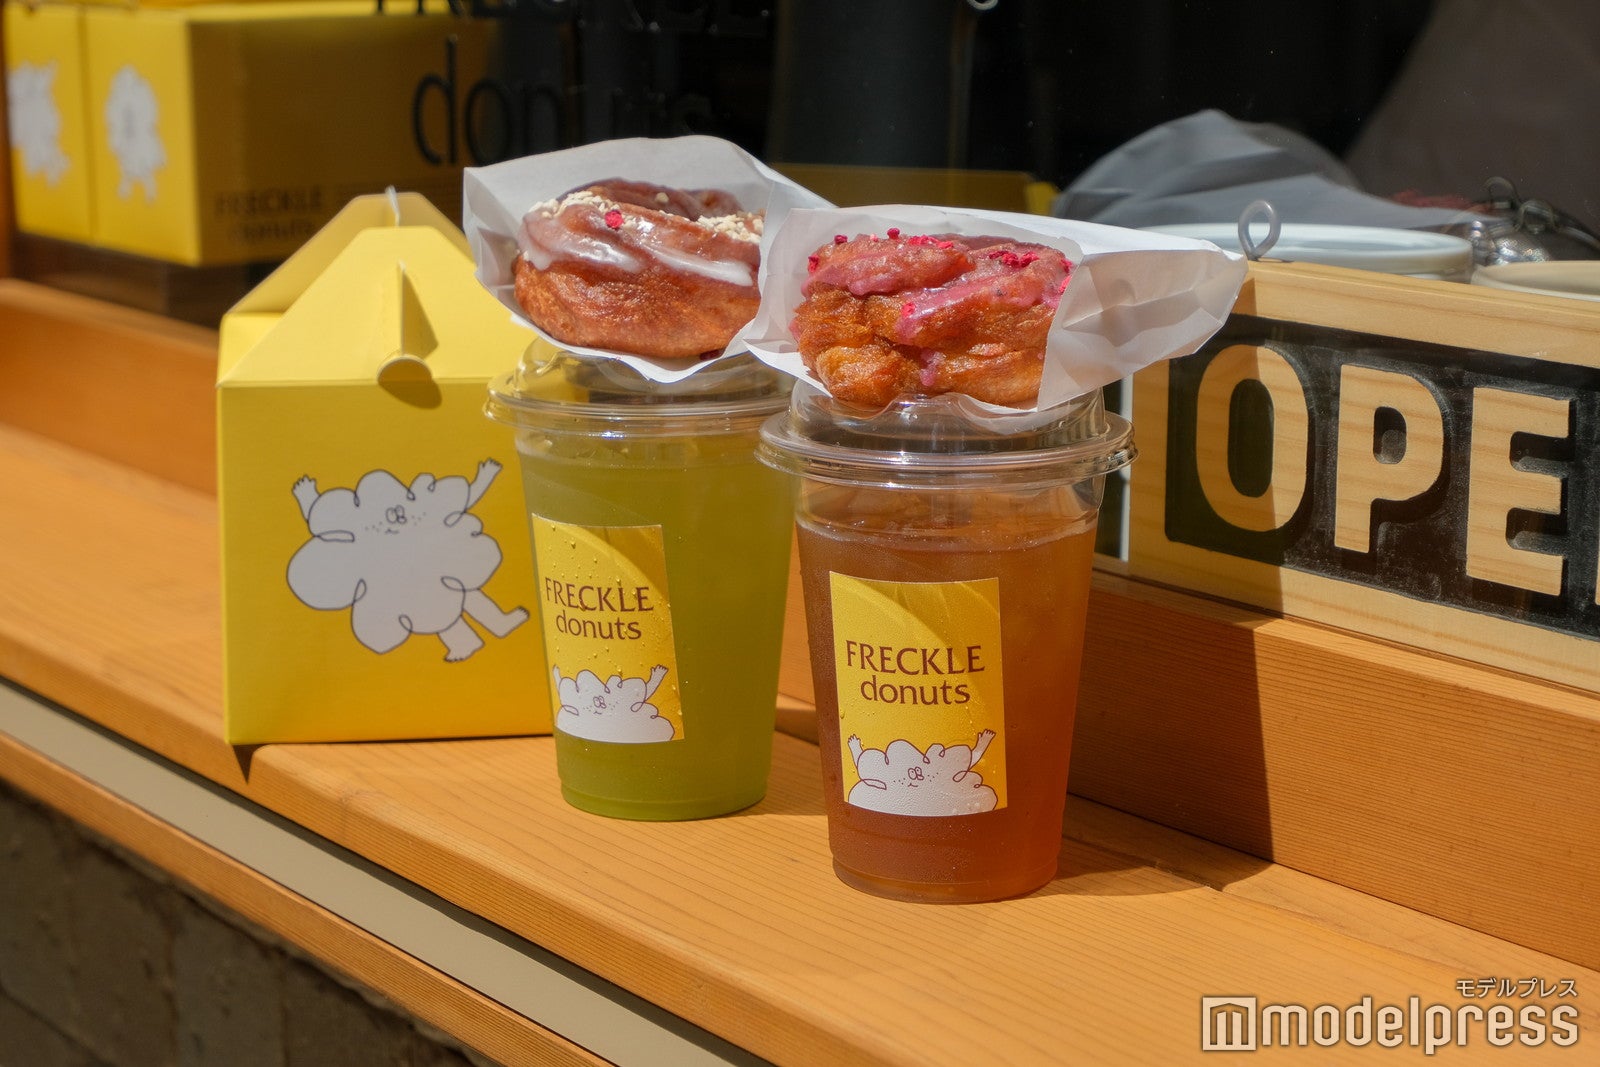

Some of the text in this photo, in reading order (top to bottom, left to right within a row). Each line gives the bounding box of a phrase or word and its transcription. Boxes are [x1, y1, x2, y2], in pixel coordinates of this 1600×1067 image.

[1196, 344, 1600, 605] OPE
[545, 577, 654, 612] FRECKLE
[556, 609, 642, 640] donuts
[846, 640, 985, 675] FRECKLE
[860, 675, 970, 705] donuts
